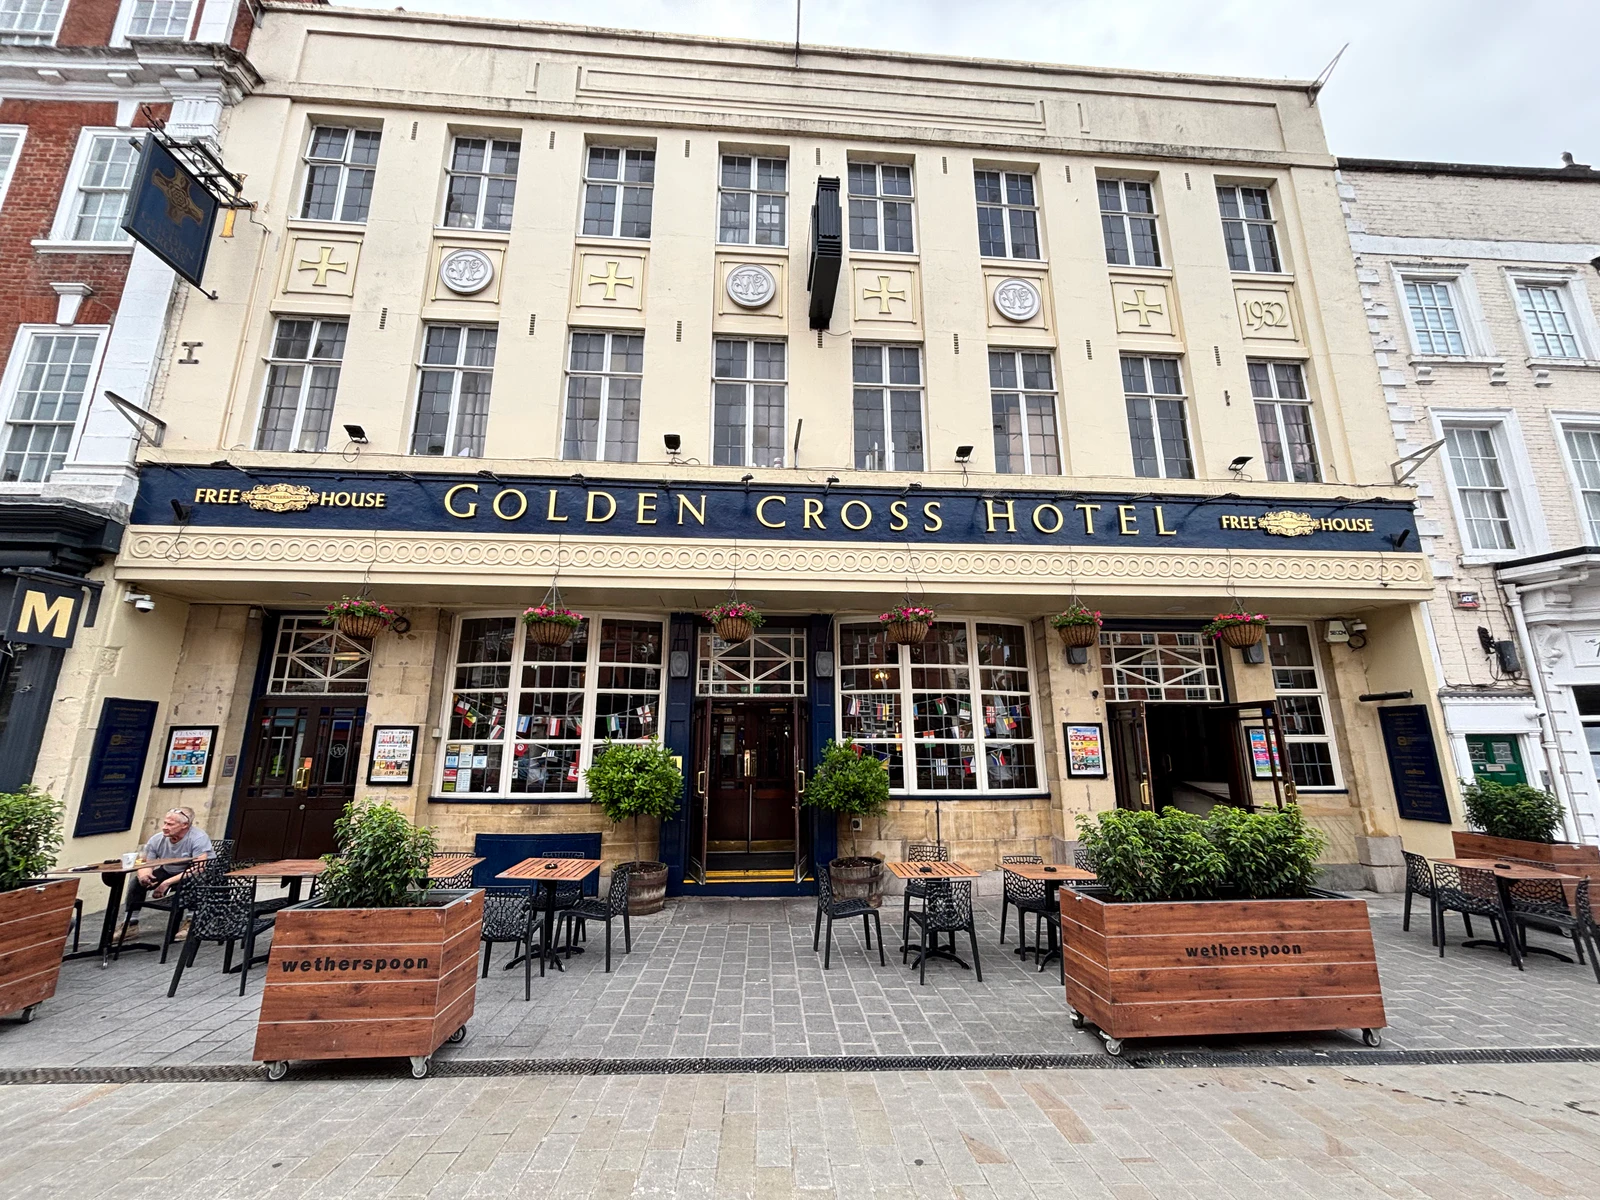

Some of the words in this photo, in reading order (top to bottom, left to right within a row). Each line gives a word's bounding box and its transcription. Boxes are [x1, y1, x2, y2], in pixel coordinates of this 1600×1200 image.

[146, 227, 185, 264] CROSS
[1243, 300, 1288, 331] 1932
[194, 488, 240, 504] FREE
[320, 491, 386, 508] HOUSE
[444, 484, 707, 526] GOLDEN
[756, 495, 943, 532] CROSS
[985, 500, 1177, 535] HOTEL
[1221, 515, 1258, 530] FREE
[1320, 517, 1375, 532] HOUSE
[17, 590, 75, 639] M
[1185, 943, 1302, 958] wetherspoon
[282, 956, 429, 973] wetherspoon
